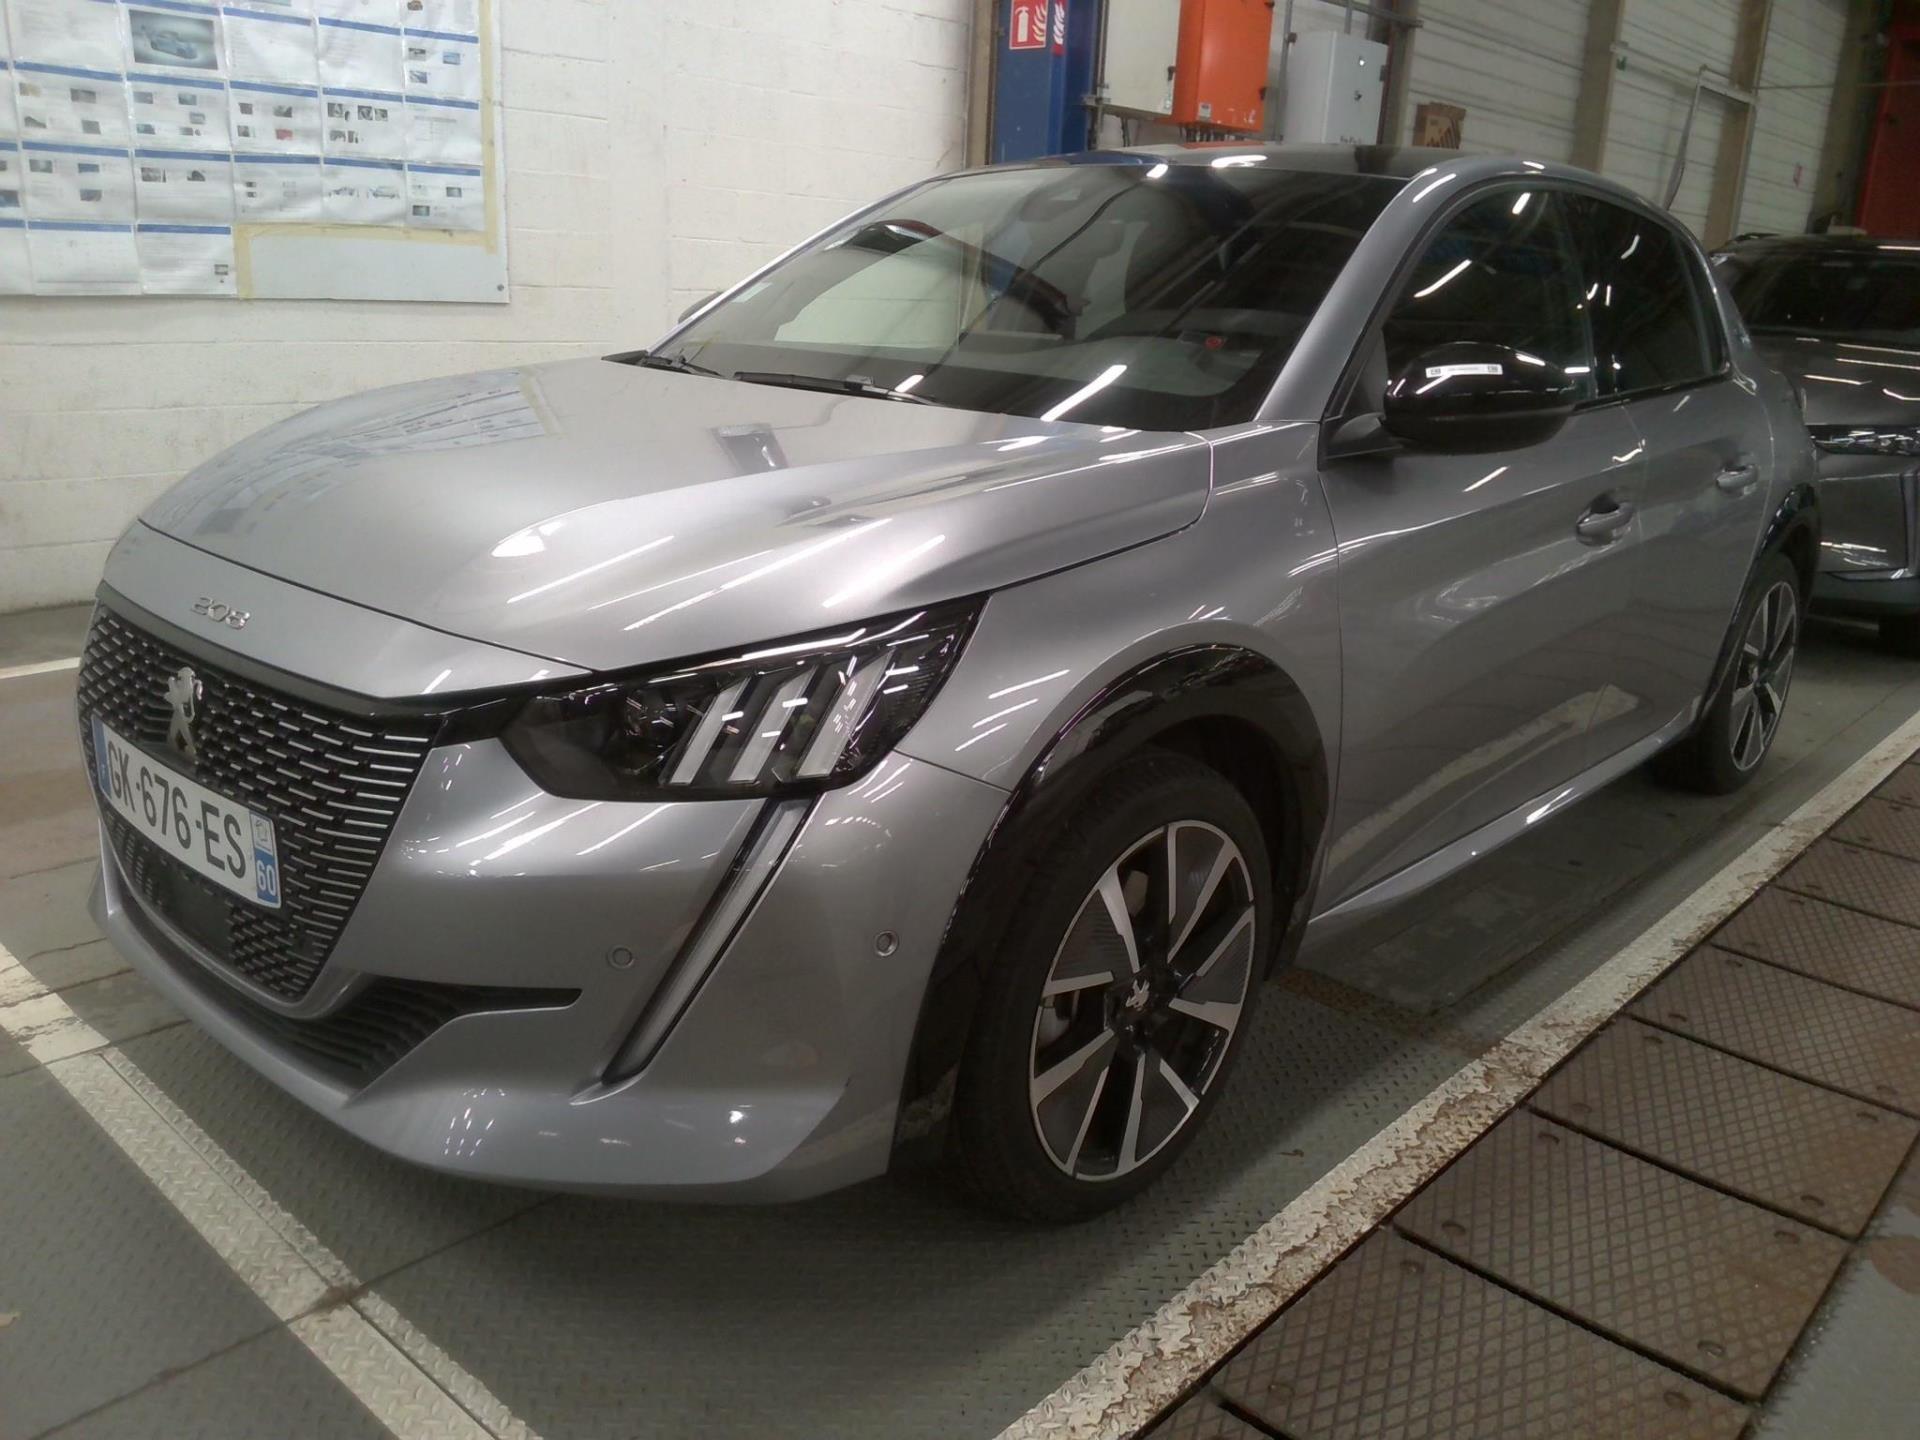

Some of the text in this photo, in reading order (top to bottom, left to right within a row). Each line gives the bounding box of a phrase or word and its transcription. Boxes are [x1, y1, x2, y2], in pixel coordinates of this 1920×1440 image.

[191, 596, 250, 630] 208
[108, 741, 246, 879] GK-676-ES
[256, 860, 277, 896] 60
